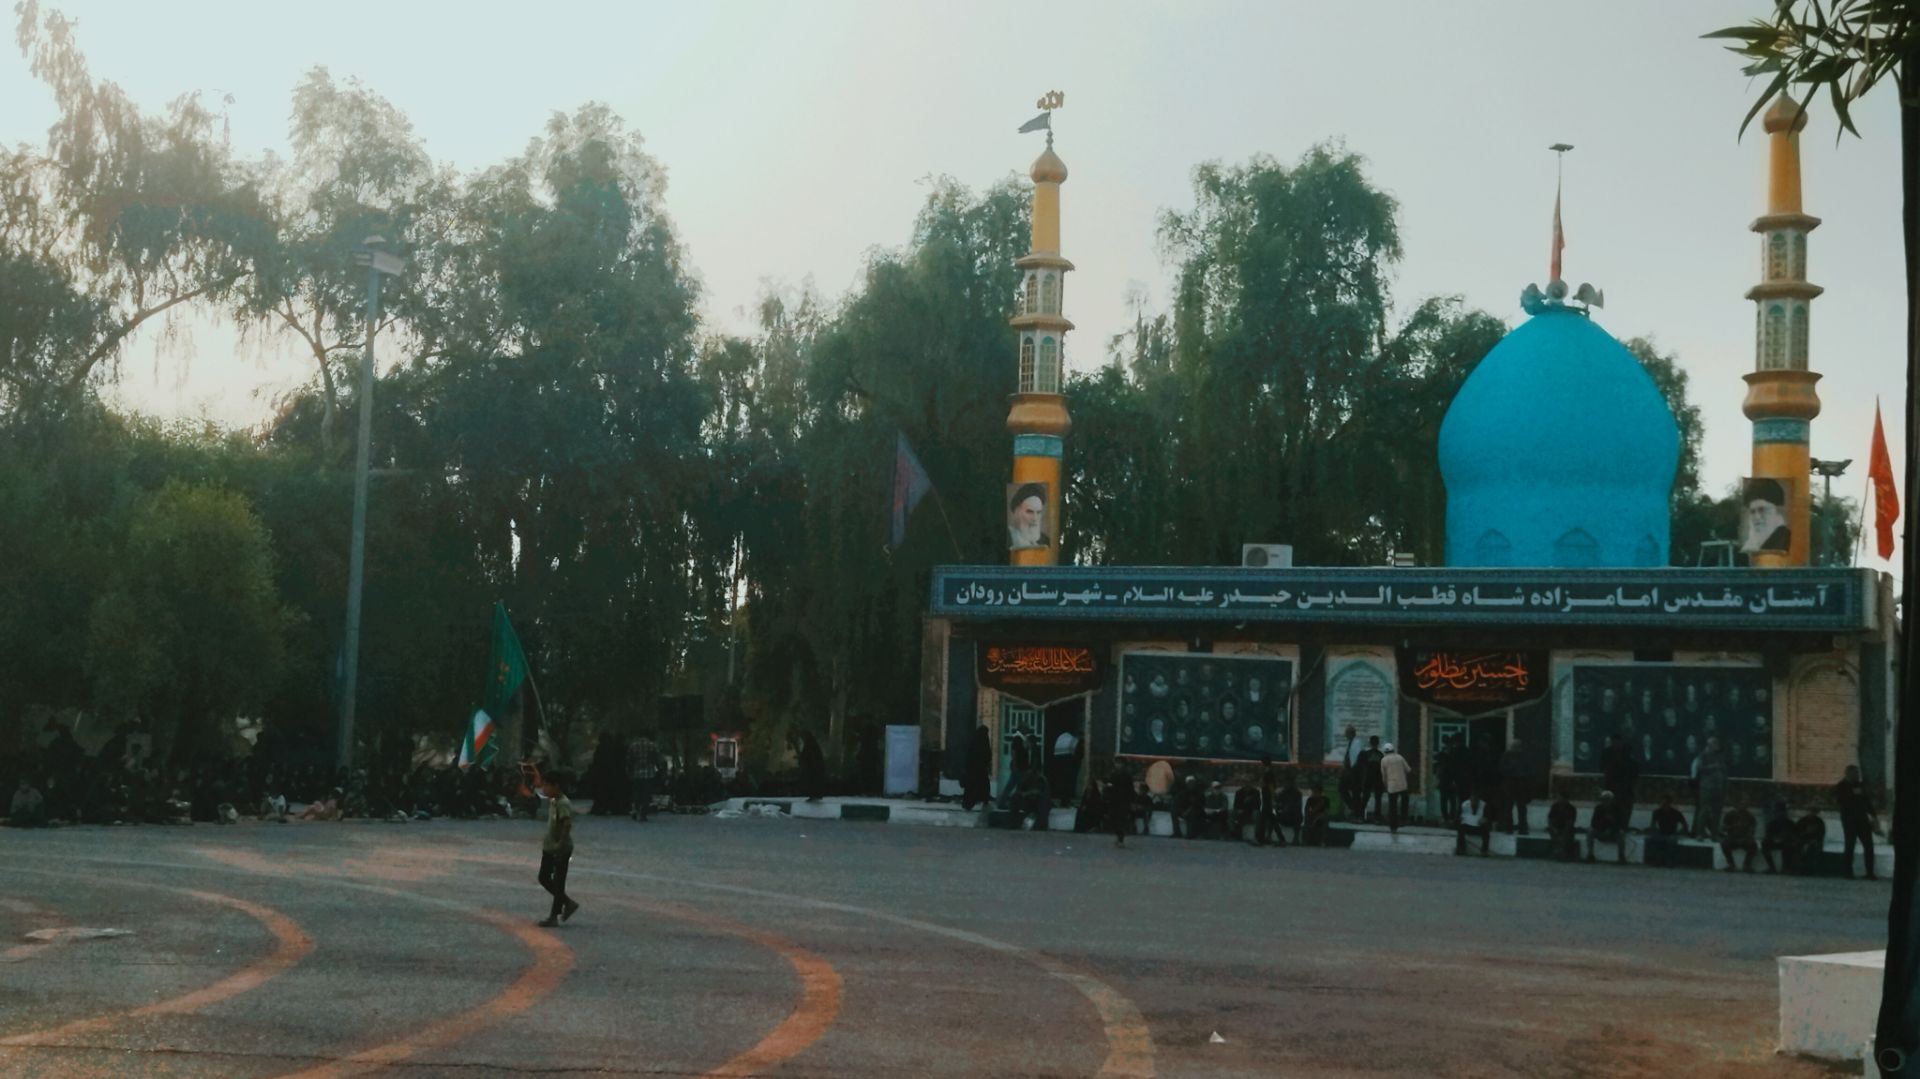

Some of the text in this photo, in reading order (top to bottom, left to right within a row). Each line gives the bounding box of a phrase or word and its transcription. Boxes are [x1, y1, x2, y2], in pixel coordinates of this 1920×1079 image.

[1036, 89, 1065, 110] الله
[956, 582, 1004, 605] رودان
[1007, 582, 1102, 606] شهرستان
[1123, 586, 1174, 604] السلام
[1177, 586, 1214, 605] علیه
[1219, 587, 1292, 608] حیدر
[1462, 585, 1525, 605] شاه
[1530, 587, 1658, 613] امامزاده
[1663, 587, 1744, 613] مقدس
[1749, 583, 1827, 613] آستان
